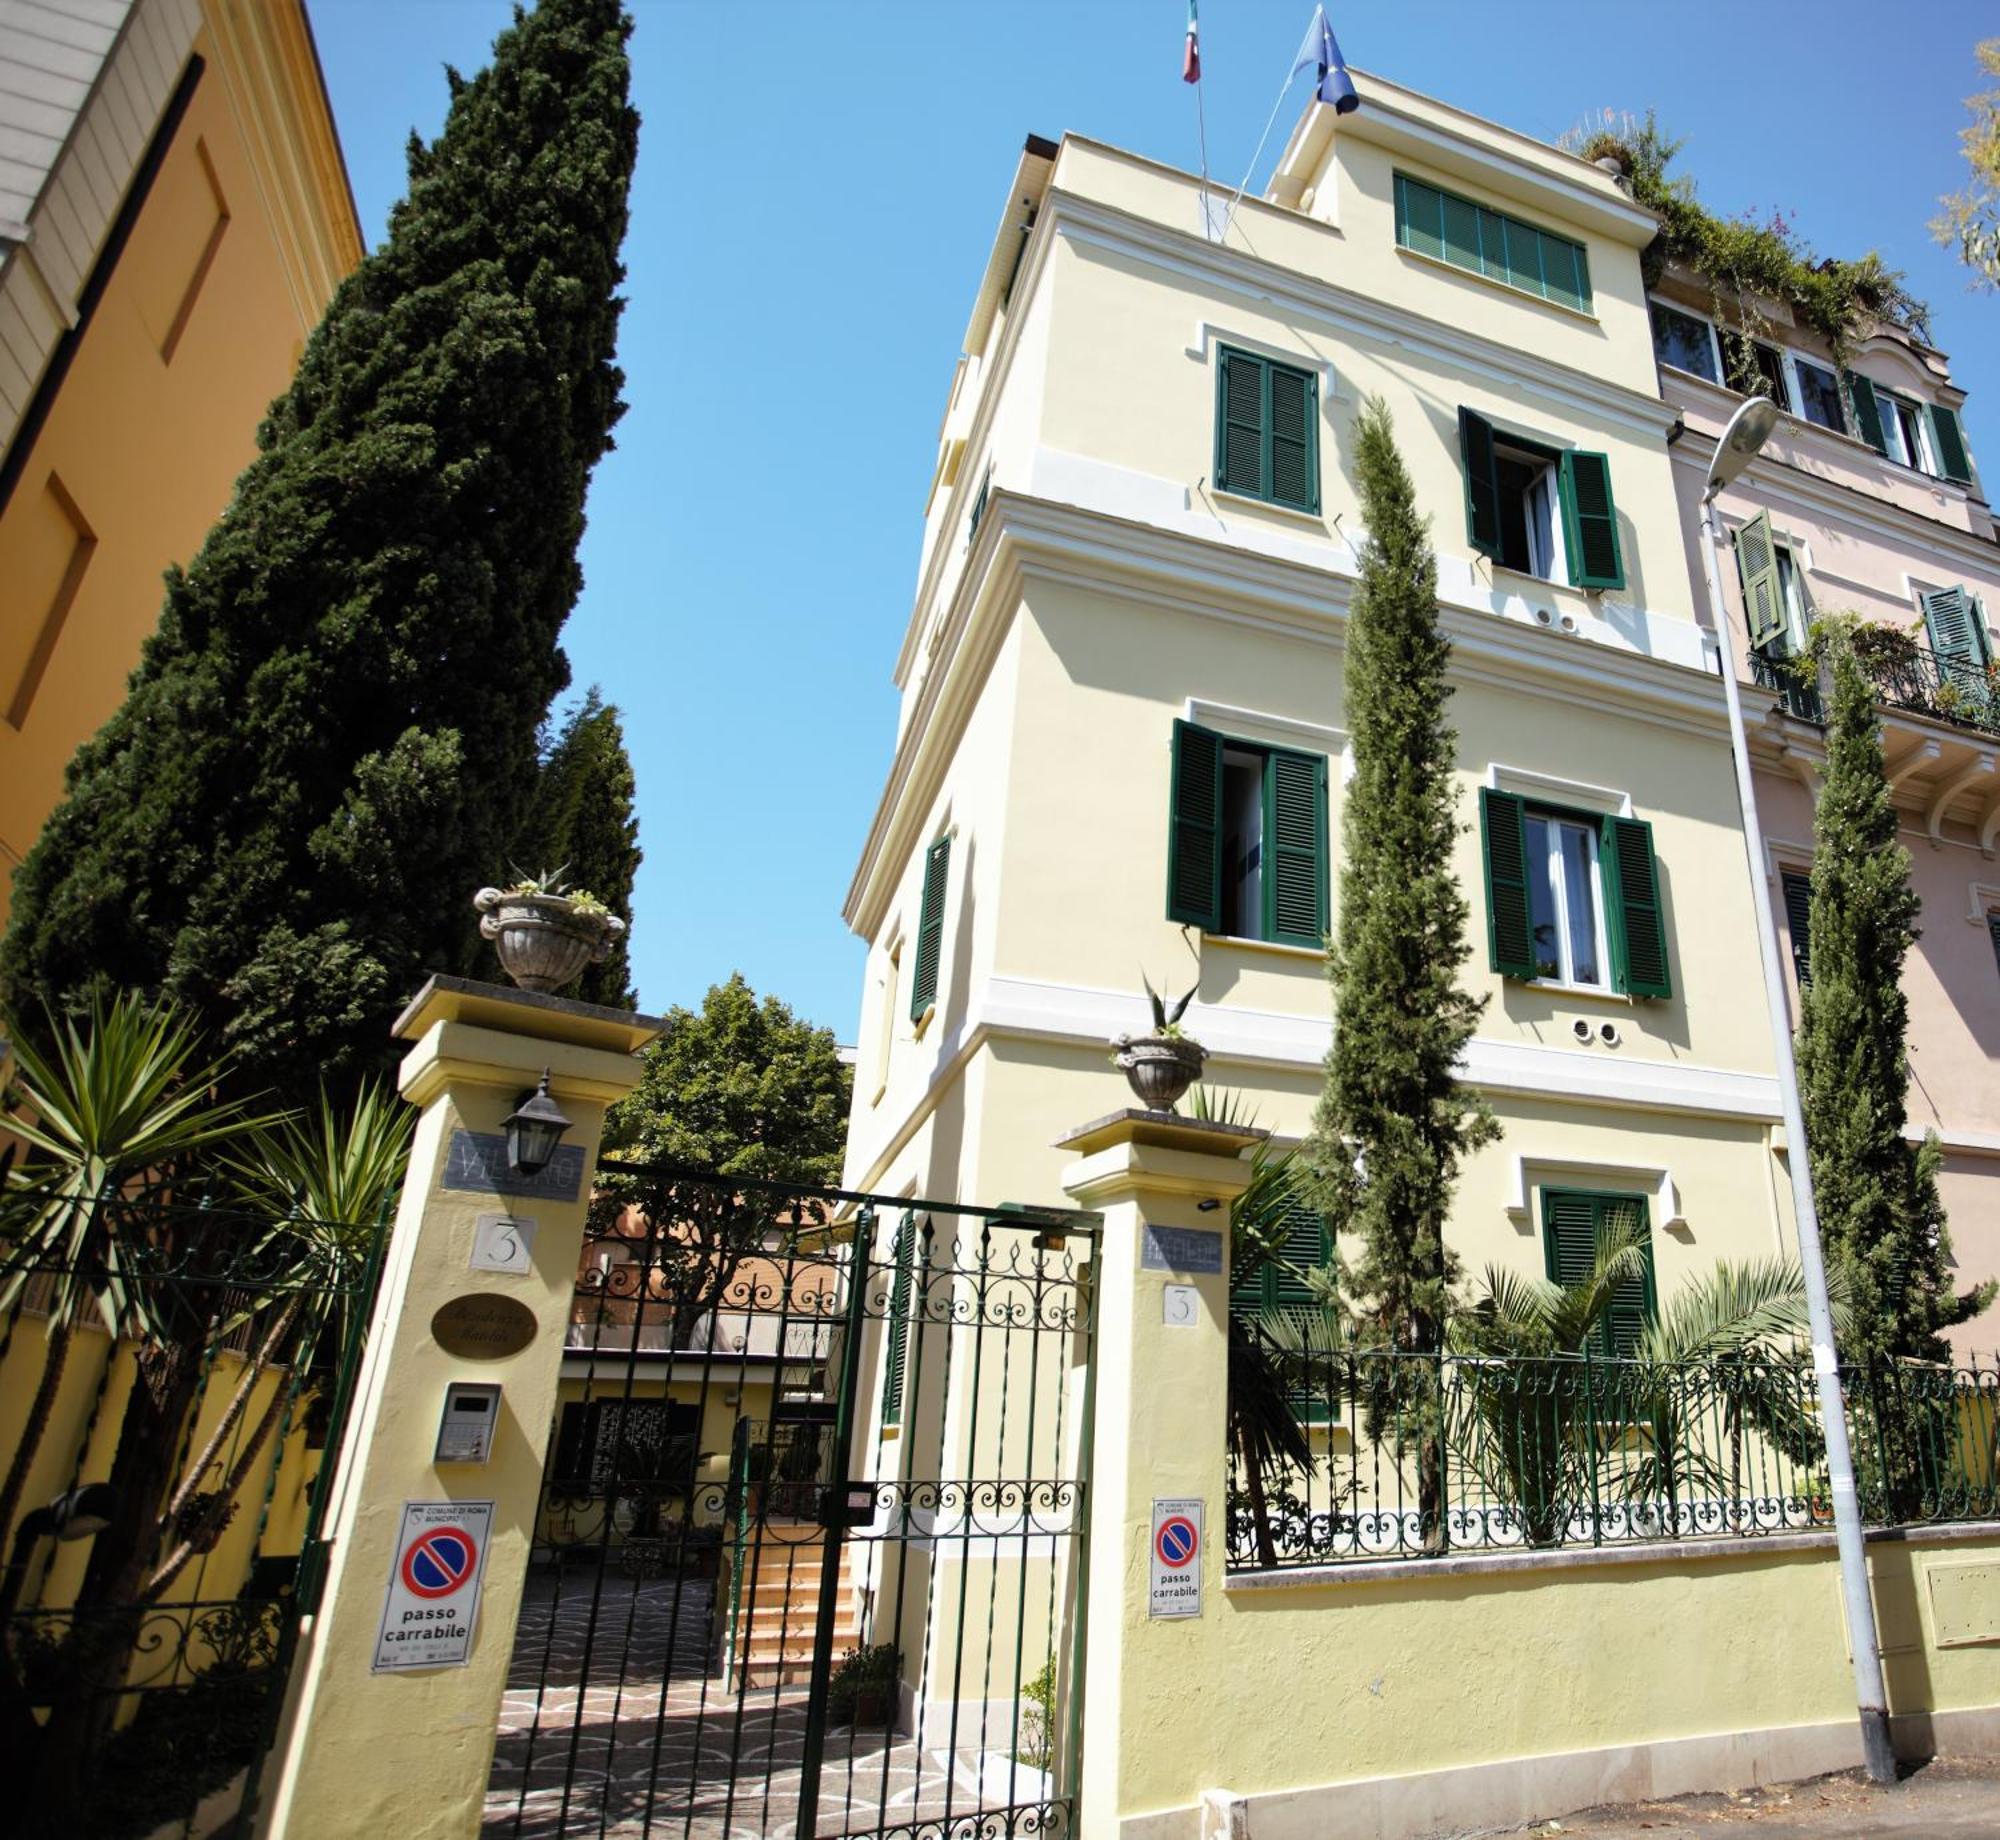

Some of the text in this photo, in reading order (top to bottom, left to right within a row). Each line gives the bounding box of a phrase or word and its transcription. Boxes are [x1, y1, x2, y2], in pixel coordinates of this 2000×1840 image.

[460, 1143, 575, 1189] VILNO
[487, 1222, 519, 1264] 3
[1172, 1289, 1189, 1321] 3
[1160, 1574, 1190, 1586] passo
[1153, 1586, 1198, 1598] carrabile
[402, 1608, 456, 1624] passo
[384, 1624, 466, 1642] carrabile
